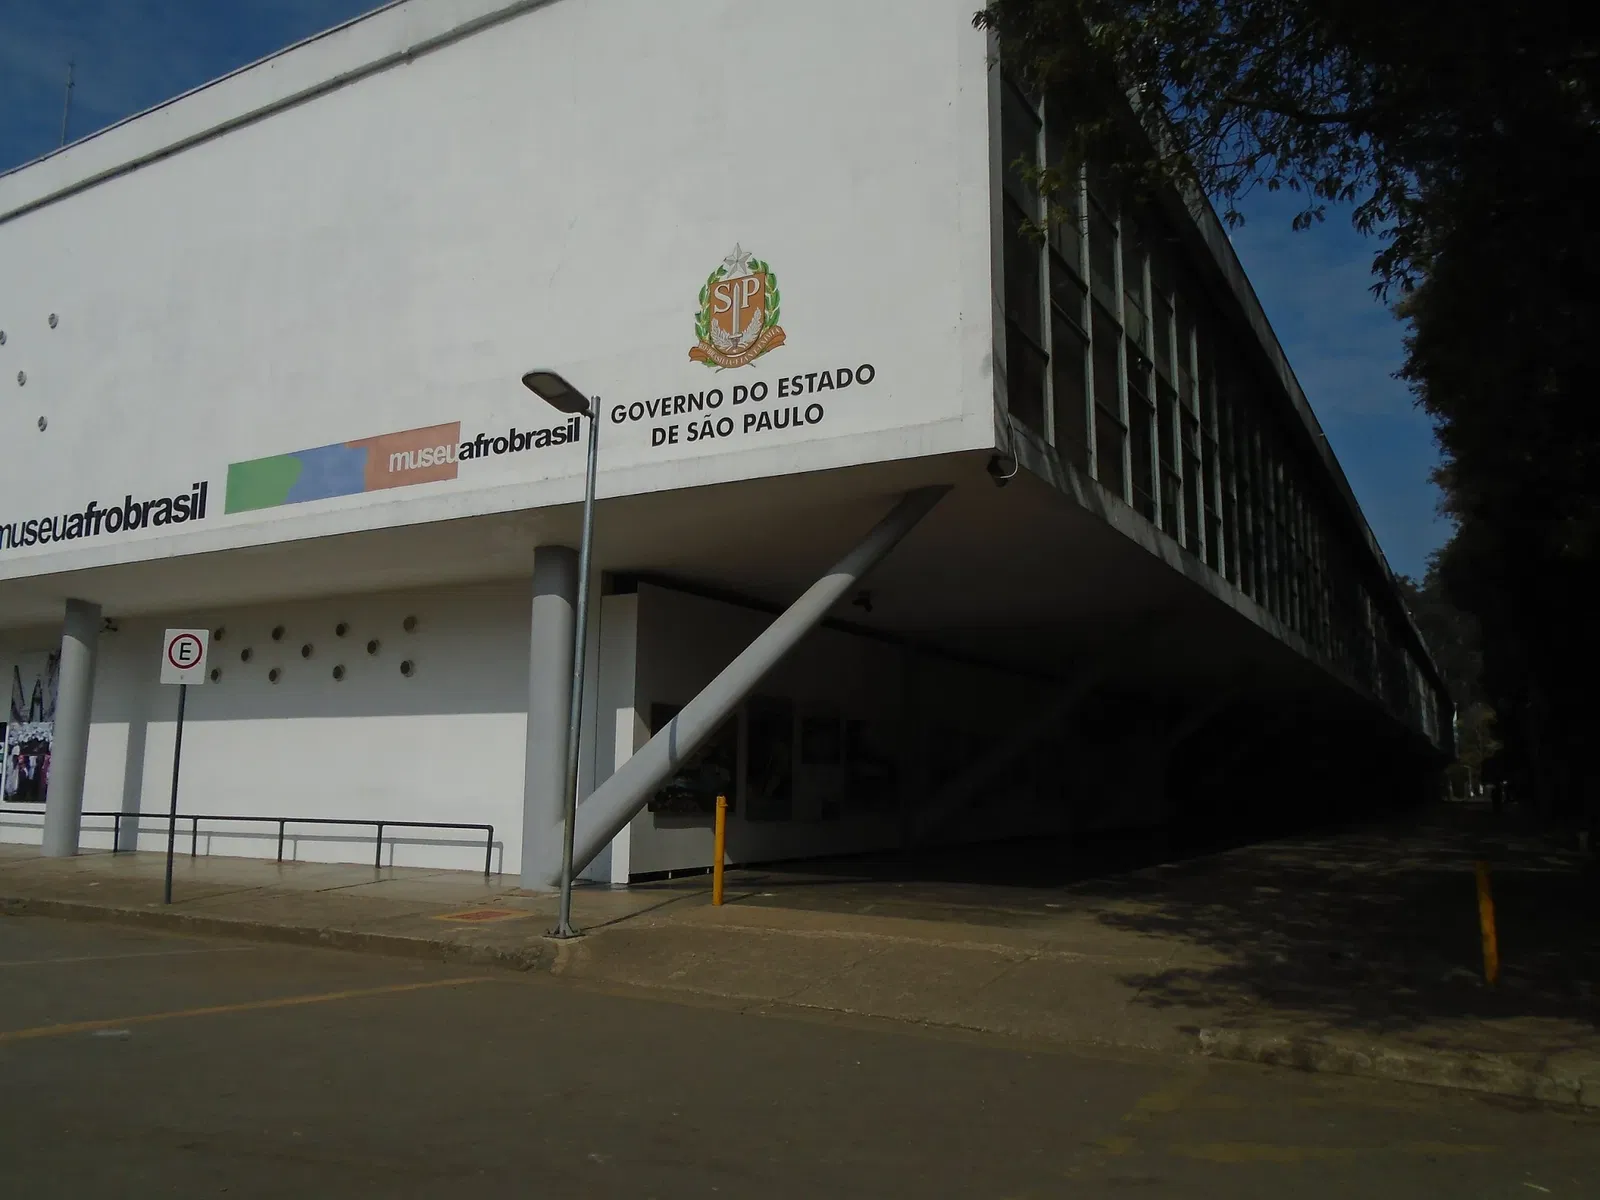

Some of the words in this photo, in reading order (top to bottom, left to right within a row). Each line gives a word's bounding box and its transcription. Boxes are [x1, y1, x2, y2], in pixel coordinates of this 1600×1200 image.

[611, 388, 724, 424] GOVERNO
[732, 381, 768, 405] DO
[777, 363, 876, 398] ESTADO
[651, 425, 679, 447] DE
[686, 413, 734, 442] SÃO
[743, 403, 824, 434] PAULO
[179, 642, 192, 660] E
